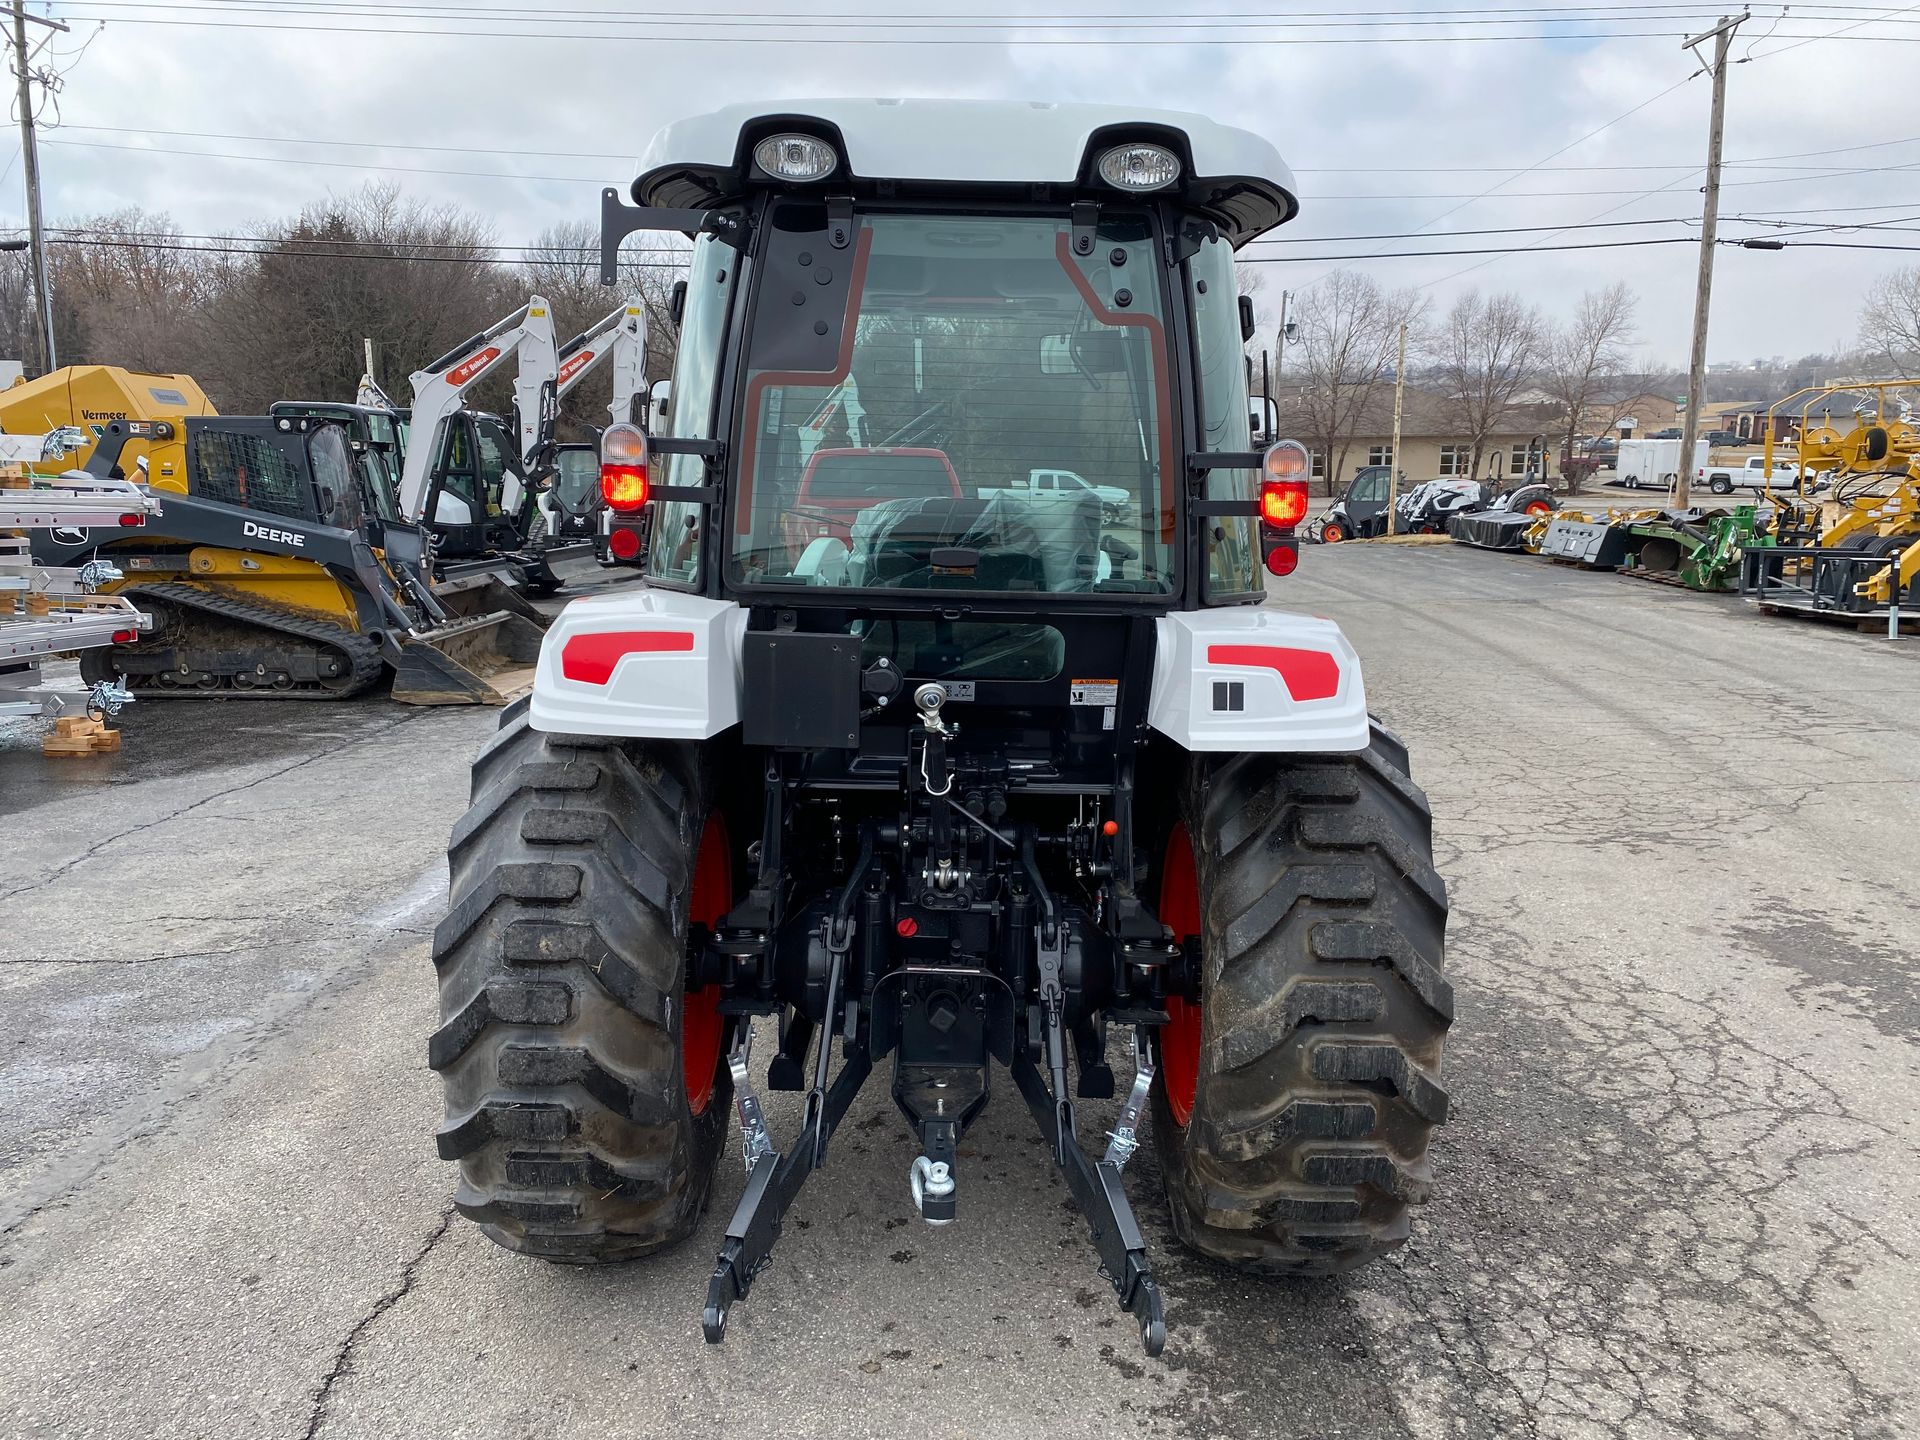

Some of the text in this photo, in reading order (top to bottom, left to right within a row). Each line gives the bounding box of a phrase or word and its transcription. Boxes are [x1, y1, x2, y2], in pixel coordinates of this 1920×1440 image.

[469, 354, 489, 371] Bobcat
[568, 357, 585, 372] Bobcat
[81, 409, 127, 420] Vermeer
[243, 521, 305, 547] DEERE
